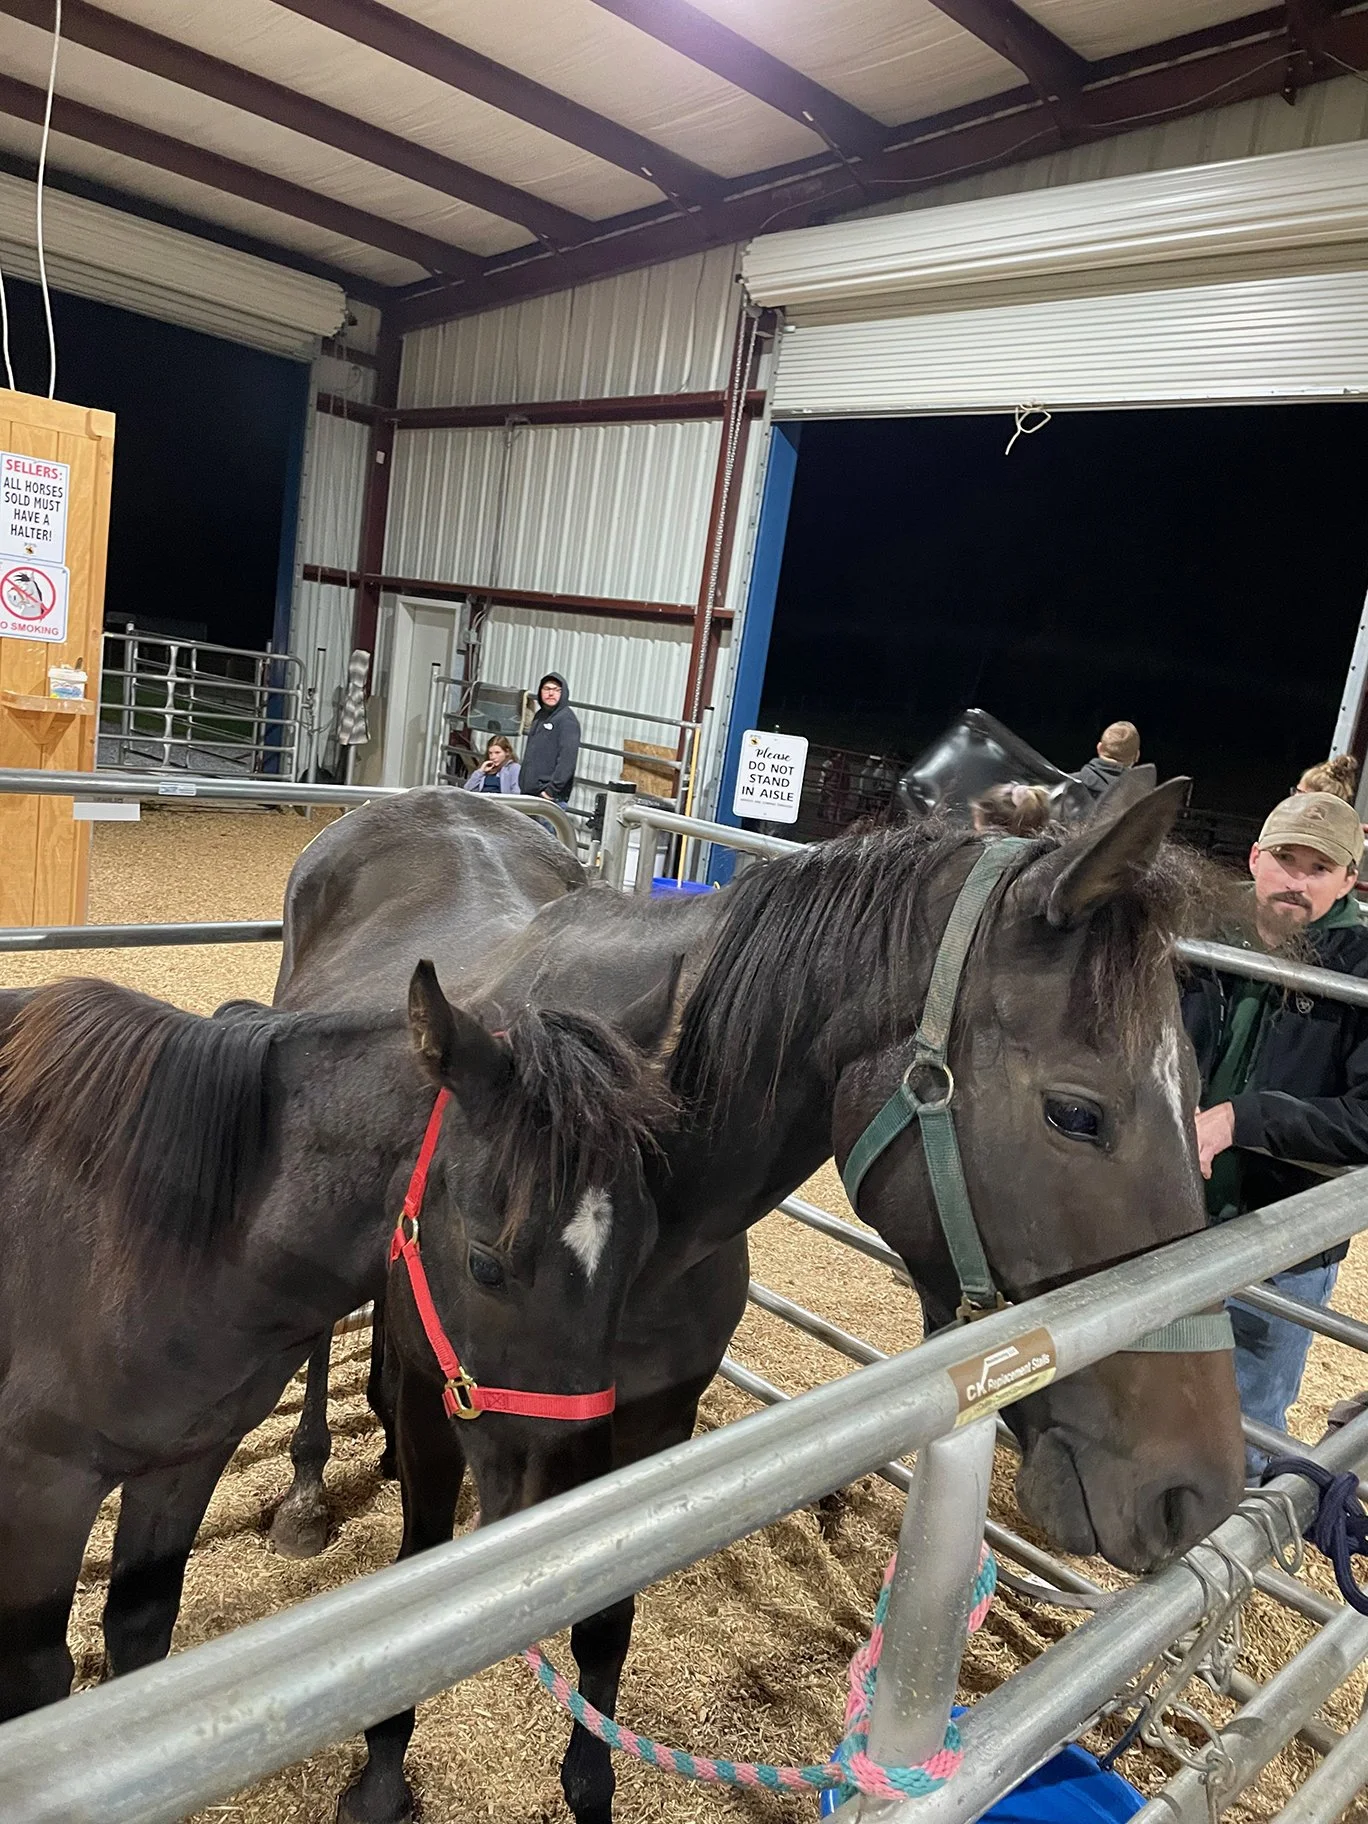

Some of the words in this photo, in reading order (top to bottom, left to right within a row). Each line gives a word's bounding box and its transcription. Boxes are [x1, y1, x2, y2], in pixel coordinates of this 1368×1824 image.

[6, 459, 62, 481] SELLERS:
[3, 477, 21, 491] ALL
[25, 480, 63, 498] HORSES
[4, 491, 31, 507] SOLD
[34, 496, 61, 512] MUST
[14, 508, 40, 523] HAVE
[42, 513, 50, 525] A
[10, 523, 52, 541] HALTER!
[0, 621, 8, 629] O
[11, 622, 59, 636] SMOKING
[748, 761, 766, 772] DO
[770, 764, 795, 776] NOT
[749, 773, 790, 787] STAND
[741, 786, 754, 796] IN
[760, 788, 794, 802] AISLE
[966, 1380, 987, 1401] CK
